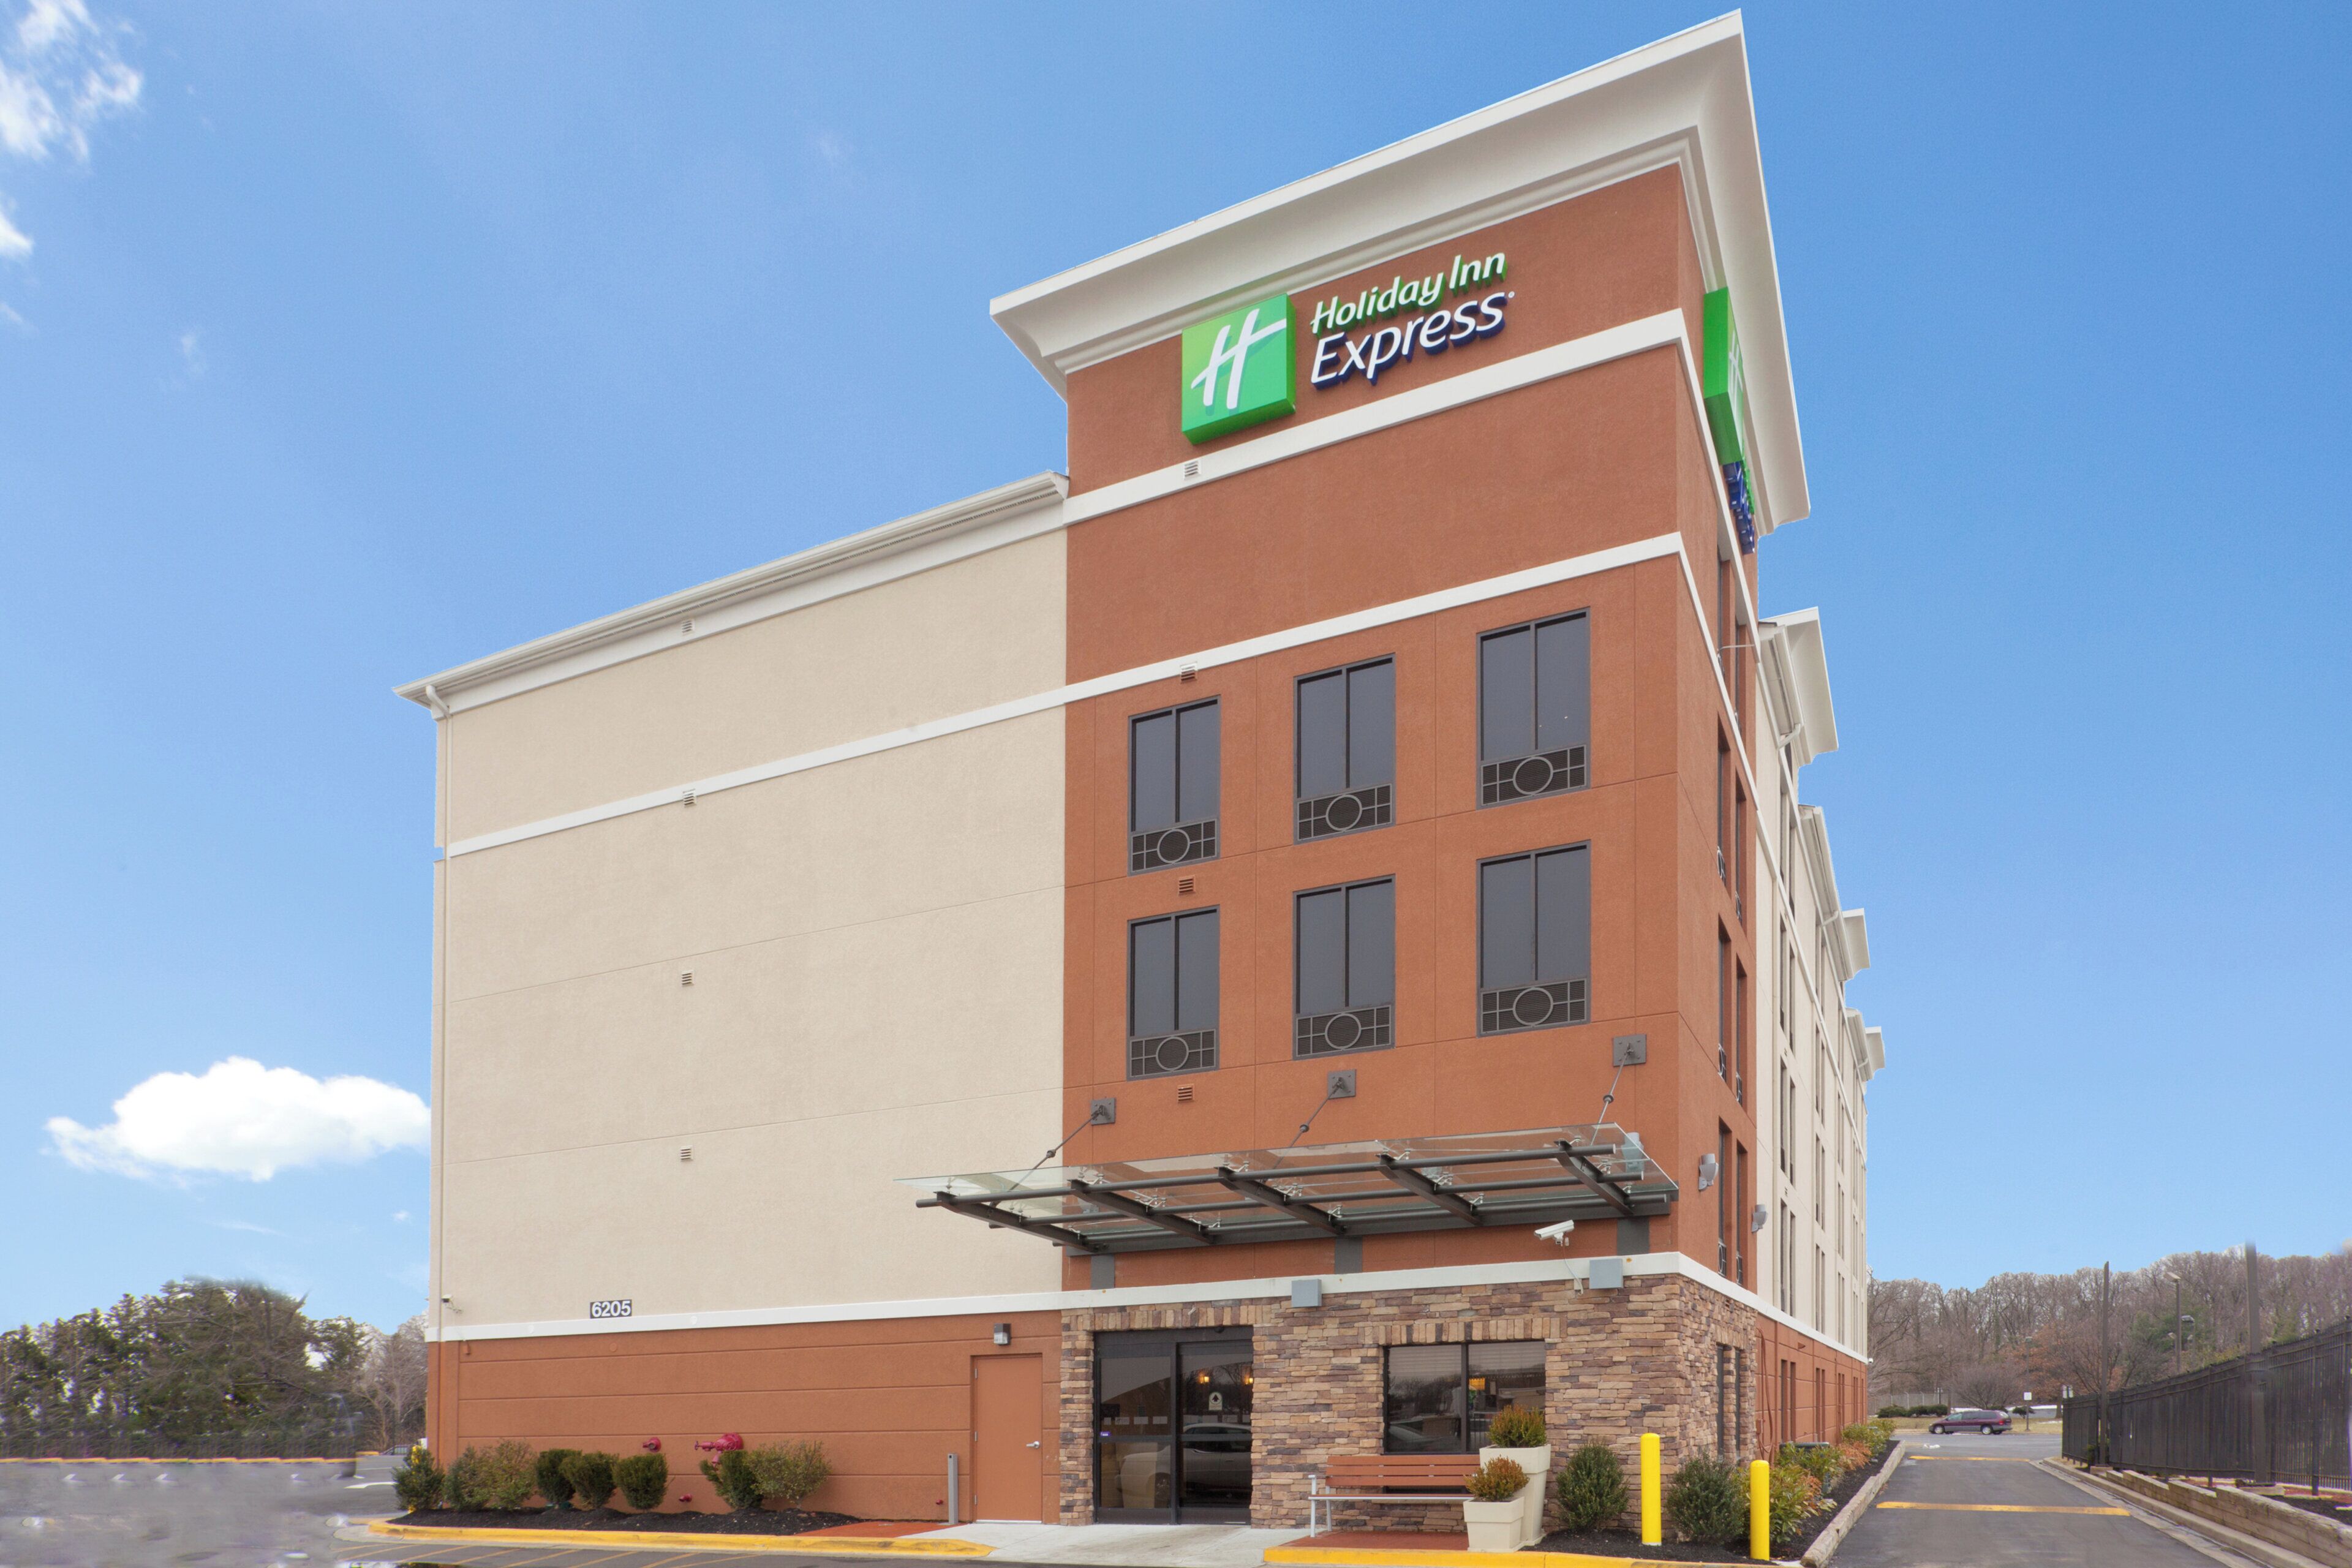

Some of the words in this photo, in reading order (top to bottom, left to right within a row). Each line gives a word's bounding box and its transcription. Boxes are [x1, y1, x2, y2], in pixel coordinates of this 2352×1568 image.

[1310, 272, 1445, 335] Holiday
[1449, 252, 1507, 290] Inn
[1191, 308, 1287, 410] H
[1311, 292, 1506, 385] Express
[591, 1300, 631, 1318] 6205
